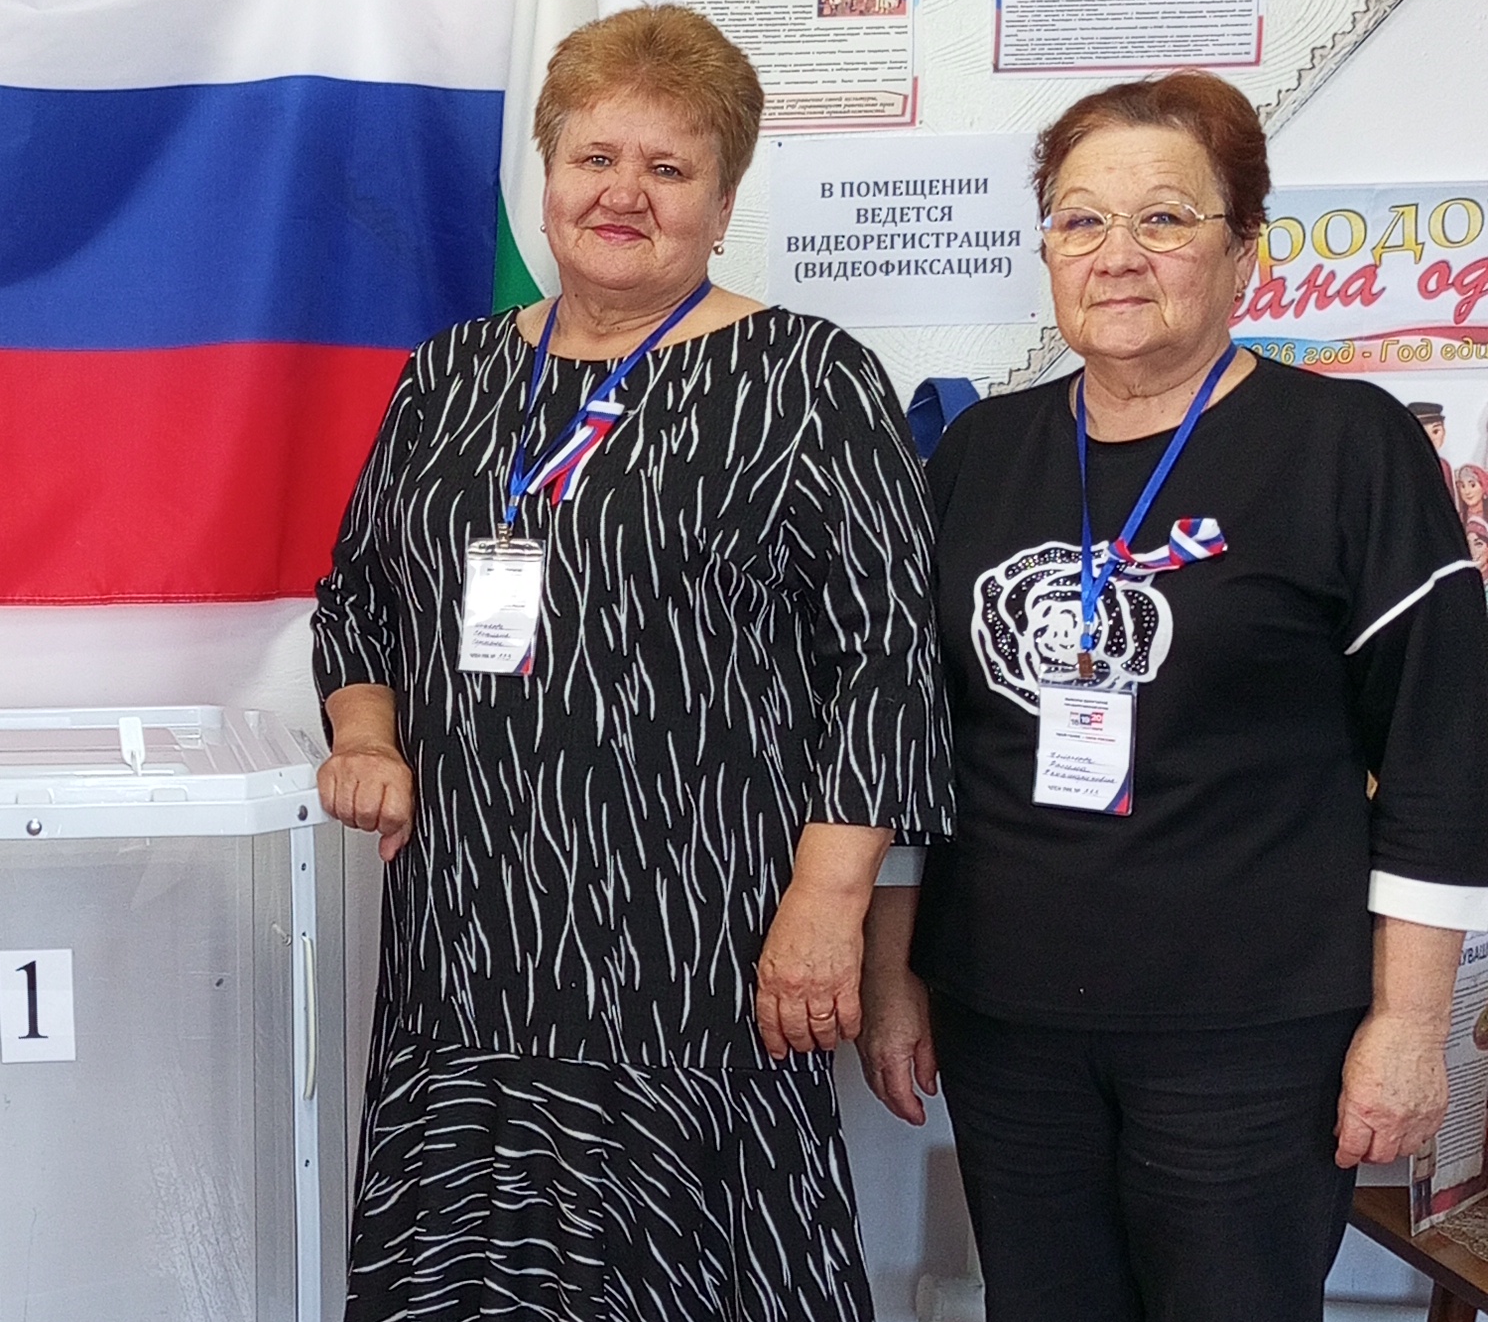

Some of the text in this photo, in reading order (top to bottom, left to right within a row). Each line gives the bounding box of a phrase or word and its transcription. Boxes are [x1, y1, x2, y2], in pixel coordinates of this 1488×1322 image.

[820, 177, 989, 200] В ПОМЕЩЕНИИ
[855, 205, 953, 227] ВЕДЕТСЯ
[786, 229, 1021, 255] ВИДЕОРЕГИСТРАЦИЯ
[1257, 197, 1488, 289] родо
[794, 255, 1013, 283] (ВИДЕОФИКСАЦИЯ)
[1228, 263, 1387, 329] ана
[1303, 339, 1356, 365] год
[1380, 339, 1433, 363] Год
[15, 960, 49, 1040] 1
